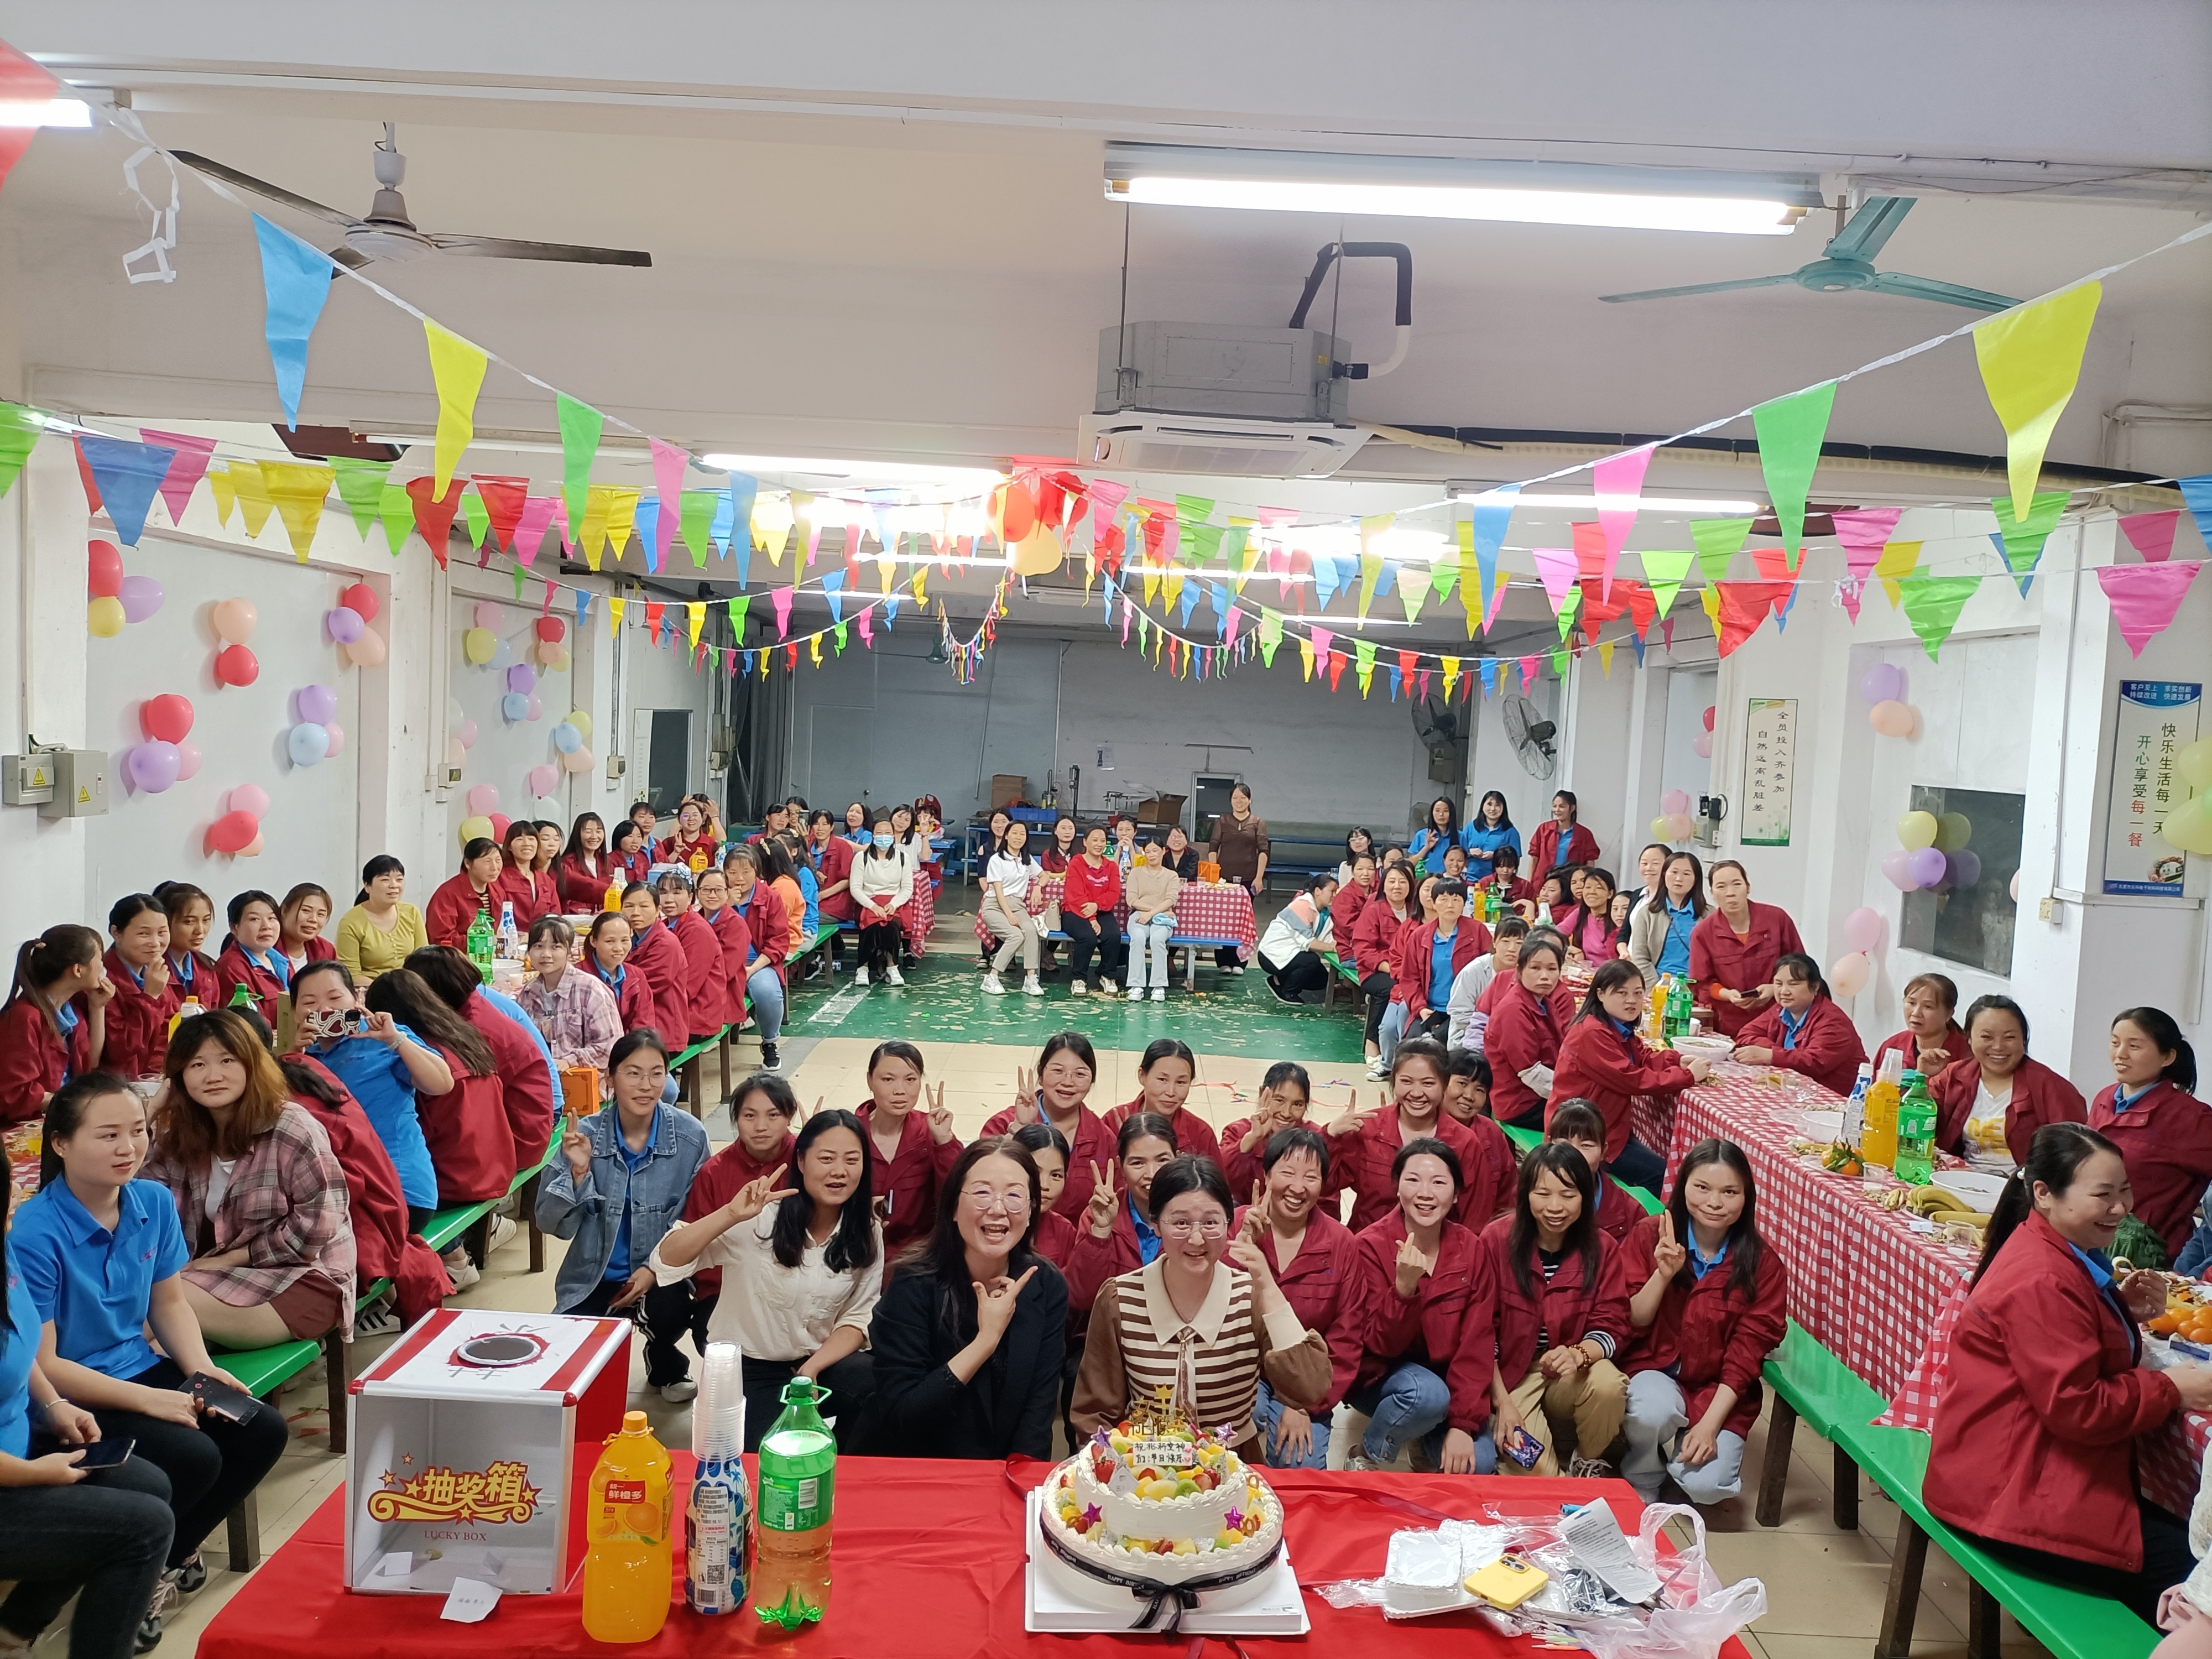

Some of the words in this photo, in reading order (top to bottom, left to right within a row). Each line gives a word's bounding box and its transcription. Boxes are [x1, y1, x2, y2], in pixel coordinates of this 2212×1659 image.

[1752, 730, 1768, 812] 自然远离乱脏差
[1773, 711, 1789, 793] 全员投入齐参加
[2128, 734, 2152, 847] 开心享受每一餐
[2152, 722, 2177, 834] 快乐生活每一天
[421, 1461, 527, 1505] 抽奖箱
[608, 1490, 642, 1500] 鲜橙多
[424, 1530, 460, 1540] LUCKY
[463, 1532, 487, 1541] BOX
[1108, 1574, 1124, 1584] HAPPY
[1236, 1568, 1257, 1579] BIRTHDAY
